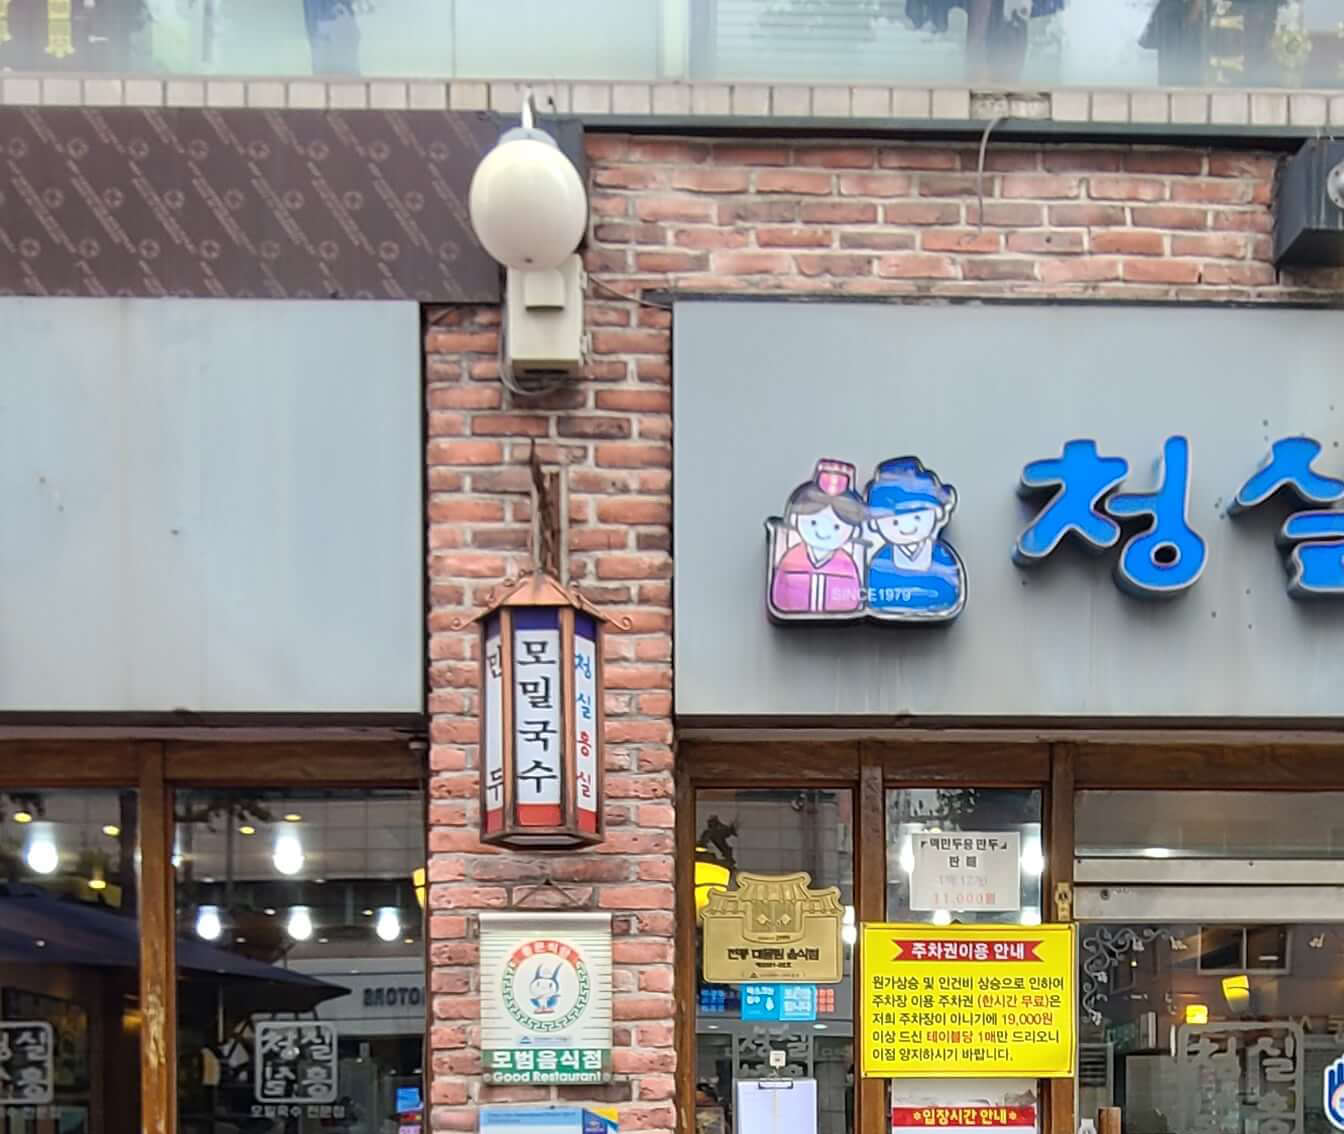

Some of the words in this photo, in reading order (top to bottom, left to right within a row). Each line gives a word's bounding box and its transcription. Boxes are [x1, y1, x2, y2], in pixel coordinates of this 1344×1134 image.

[517, 641, 557, 793] 모밀국수
[575, 653, 593, 798] 청실홍실
[911, 942, 989, 959] 주차권이용
[993, 942, 1025, 959] 안내
[872, 976, 919, 990] 원가상승
[923, 976, 934, 990] 및
[939, 976, 973, 990] 인건비
[978, 976, 1025, 990] 상승으로
[1029, 976, 1064, 990] 인하여
[872, 995, 907, 1008] 주차장
[911, 995, 934, 1008] 이용
[939, 995, 973, 1008] 주차권
[872, 1013, 895, 1026] 저희
[899, 1013, 946, 1026] 주차장이
[950, 1013, 997, 1026] 아니기에
[1002, 1013, 1052, 1026] 19,000원
[872, 1031, 895, 1044] 이상
[899, 1031, 922, 1044] 드신
[927, 1031, 973, 1044] 테이블당
[1012, 1031, 1059, 1044] 드리오니
[492, 1050, 602, 1070] 모범음식점
[872, 1048, 896, 1061] 이점
[899, 1048, 958, 1061] 양지하시기
[962, 1048, 1013, 1061] 바랍니다.
[493, 1072, 530, 1083] Good
[533, 1072, 601, 1083] Restaurant
[923, 1109, 977, 1125] 입장시간
[979, 1109, 1007, 1125] 안내
